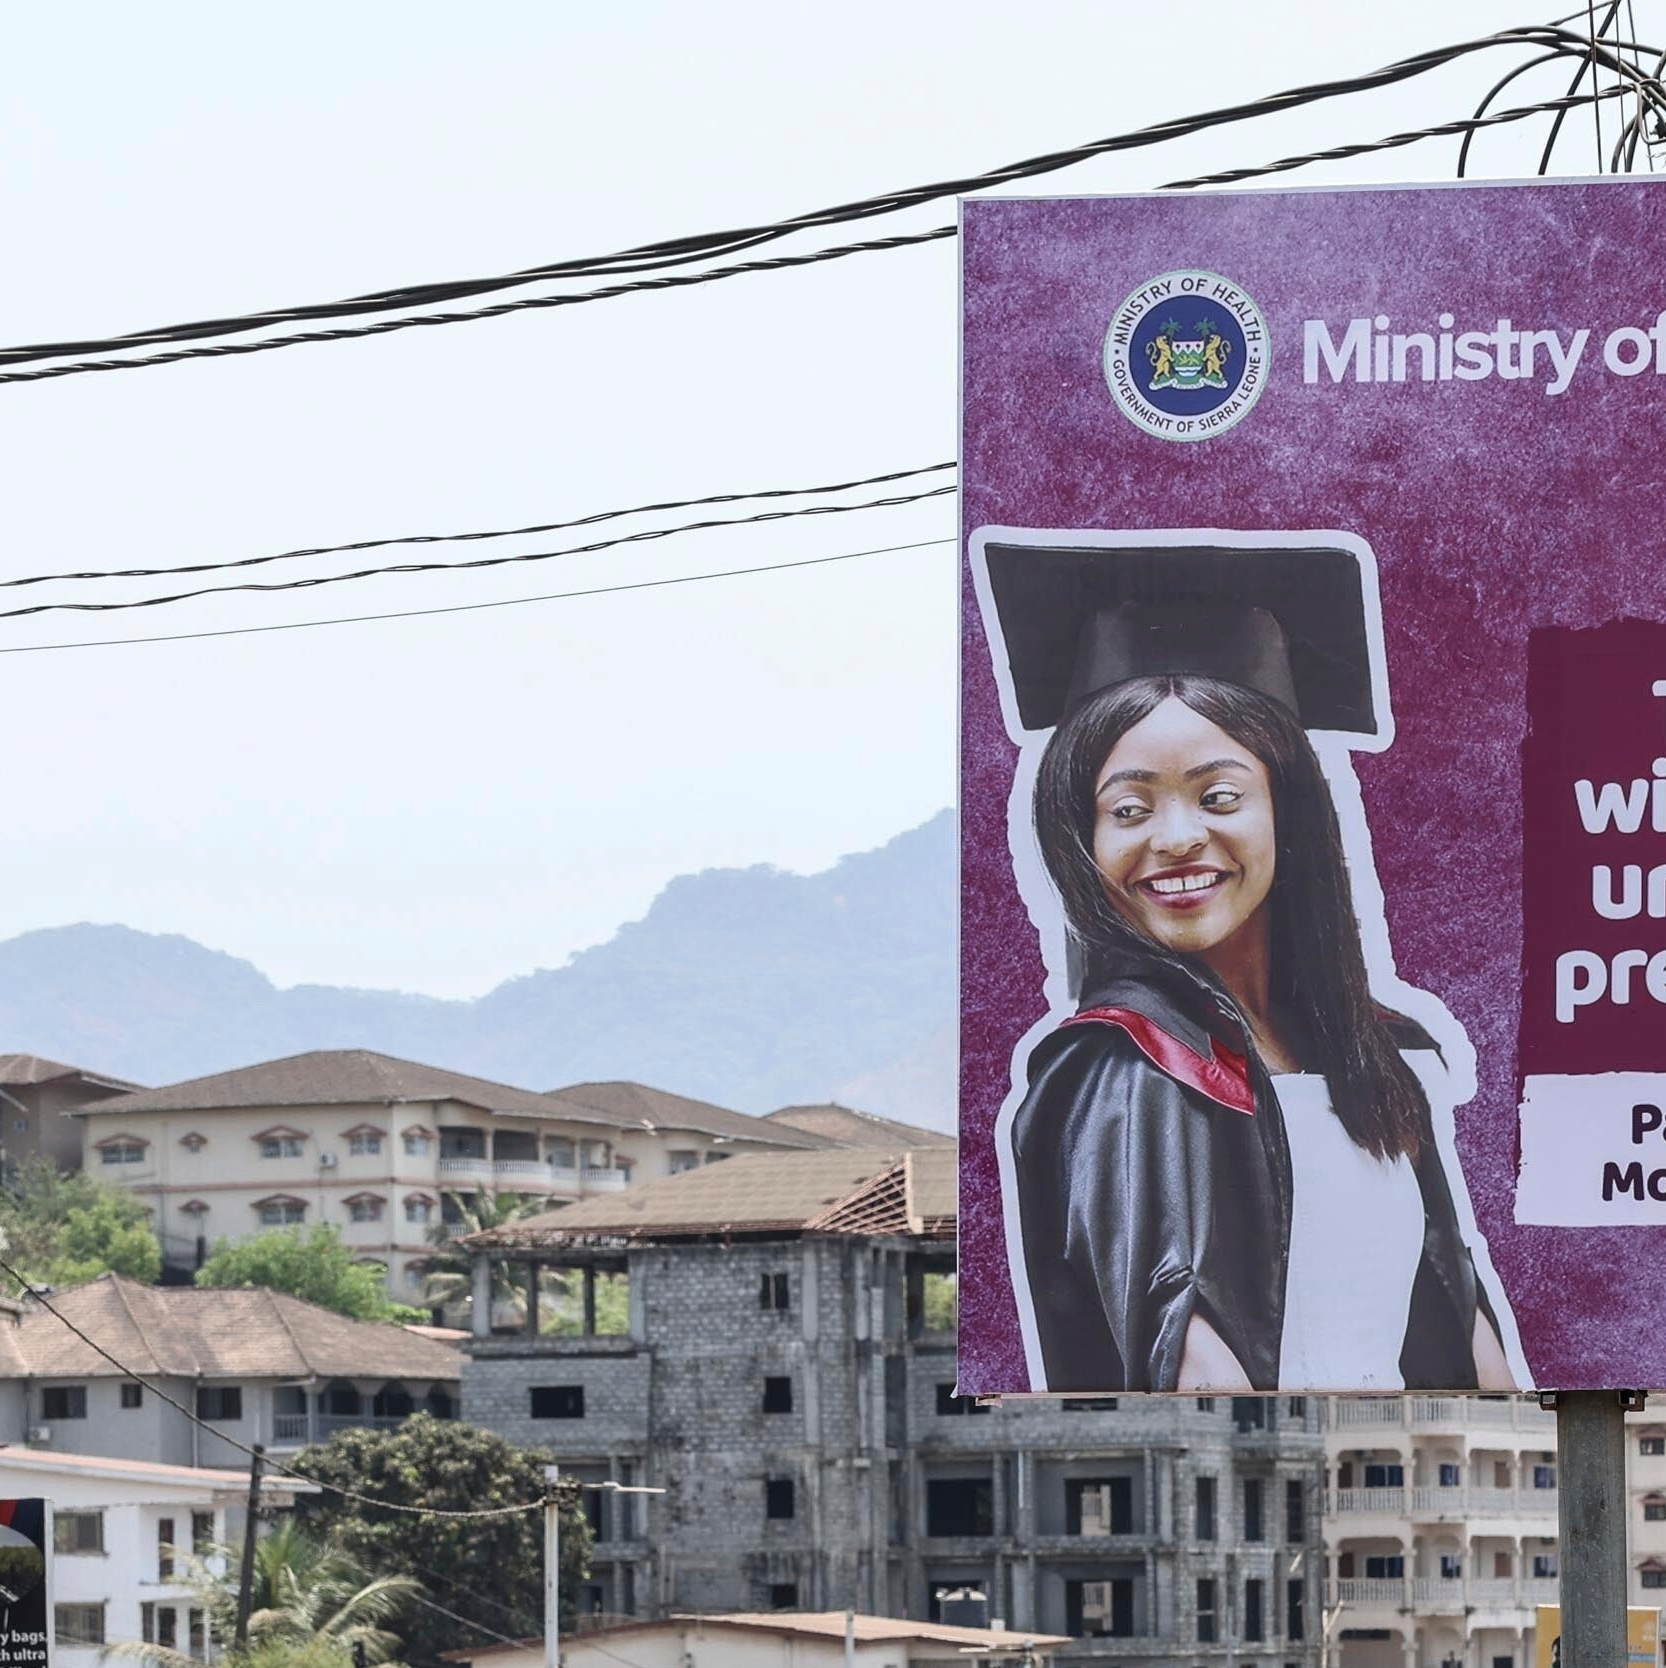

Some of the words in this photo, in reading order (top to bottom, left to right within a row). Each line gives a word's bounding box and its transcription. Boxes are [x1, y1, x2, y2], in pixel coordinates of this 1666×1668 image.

[1114, 280, 1172, 345] MINISTRY
[1181, 278, 1207, 292] OF
[1212, 283, 1261, 342] HEALTH
[1303, 314, 1590, 395] Ministry
[1113, 359, 1173, 430] GOVERNMENT
[1177, 421, 1194, 432] OF
[1199, 400, 1242, 431] SIERRA
[1238, 356, 1261, 400] LEONE
[13, 1648, 46, 1660] ultra
